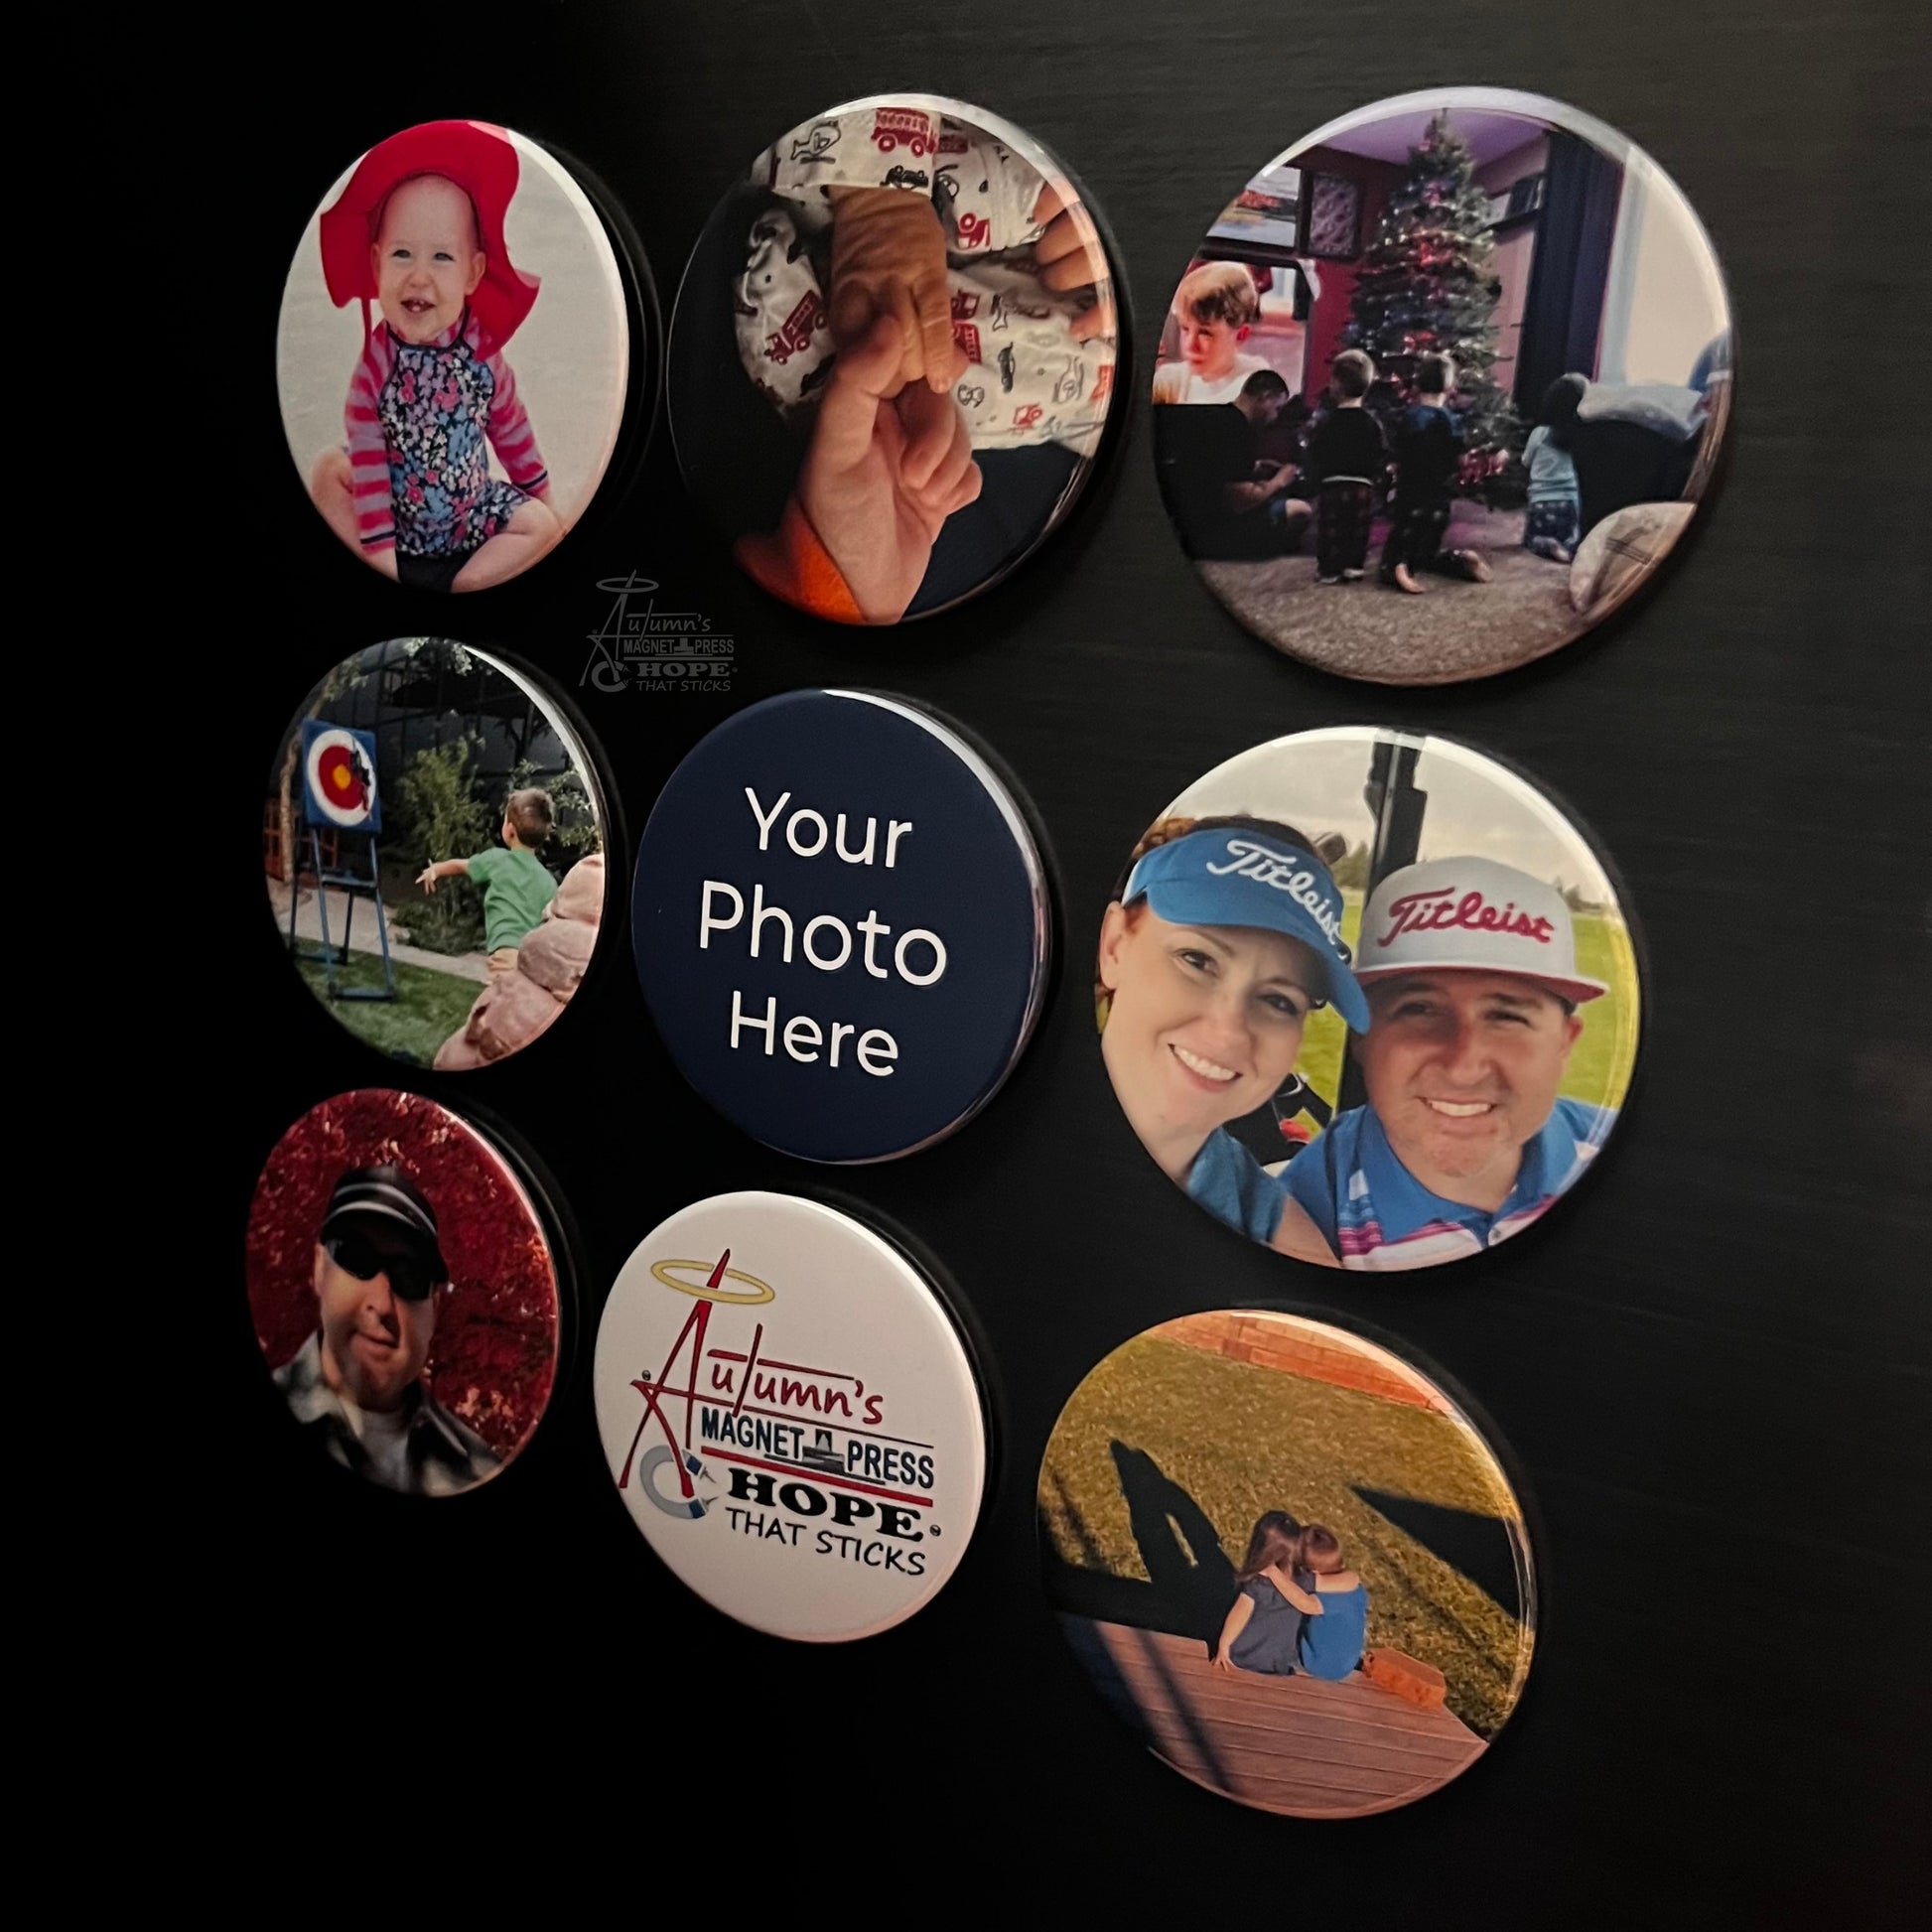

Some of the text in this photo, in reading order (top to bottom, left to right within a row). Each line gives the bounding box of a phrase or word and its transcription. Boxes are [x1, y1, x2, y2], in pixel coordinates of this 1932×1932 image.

[745, 787, 912, 868] Your
[700, 880, 947, 986] Photo
[1206, 839, 1341, 945] Titleist
[1377, 887, 1555, 947] Titleist
[731, 990, 898, 1077] Here
[619, 1249, 883, 1498] Autumn's
[701, 1407, 934, 1489] MAGNET PRESS
[726, 1507, 926, 1577] THAT STICKS
[728, 1467, 924, 1542] HOPE
